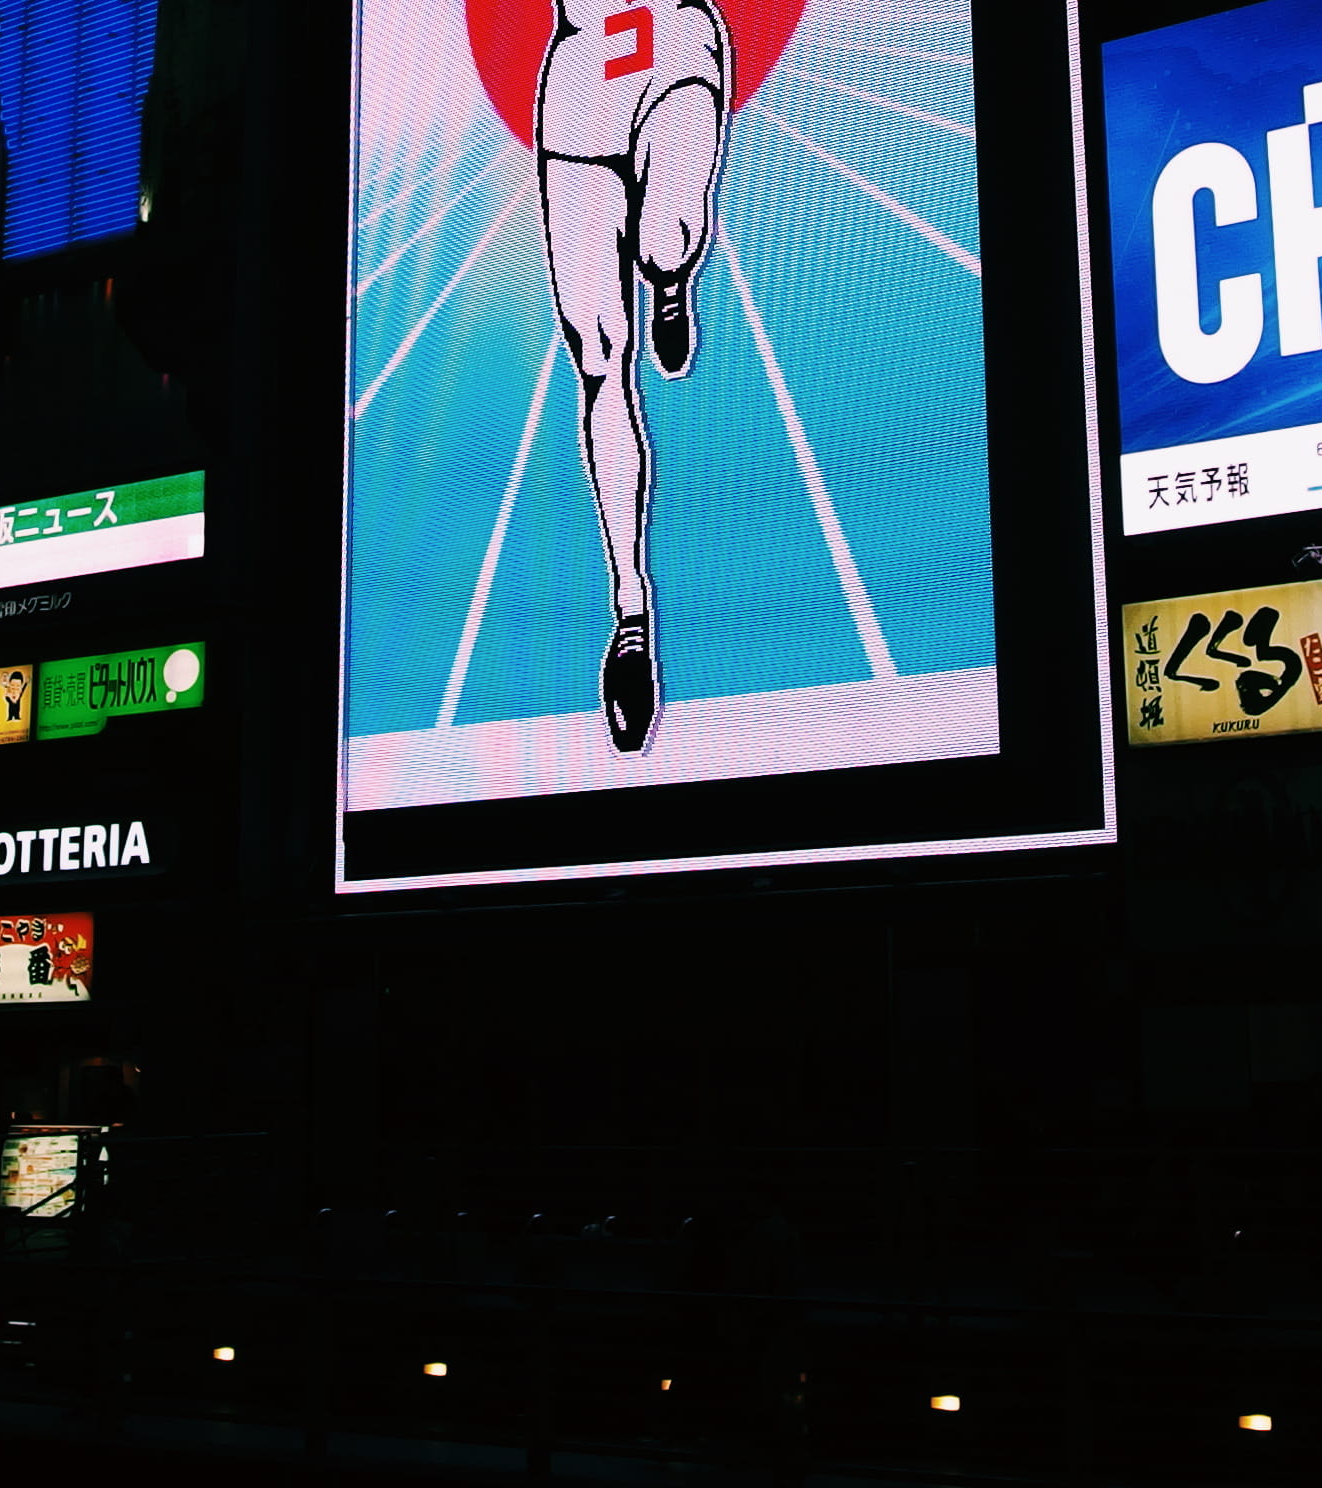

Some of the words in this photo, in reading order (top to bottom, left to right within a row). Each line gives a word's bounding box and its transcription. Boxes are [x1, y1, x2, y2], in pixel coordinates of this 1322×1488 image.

[1147, 462, 1250, 510] 天気予報
[88, 657, 157, 710] ピタットハウス
[1134, 615, 1165, 731] 道頓堀
[1164, 606, 1304, 716] くくる
[1212, 718, 1260, 735] KUKURU
